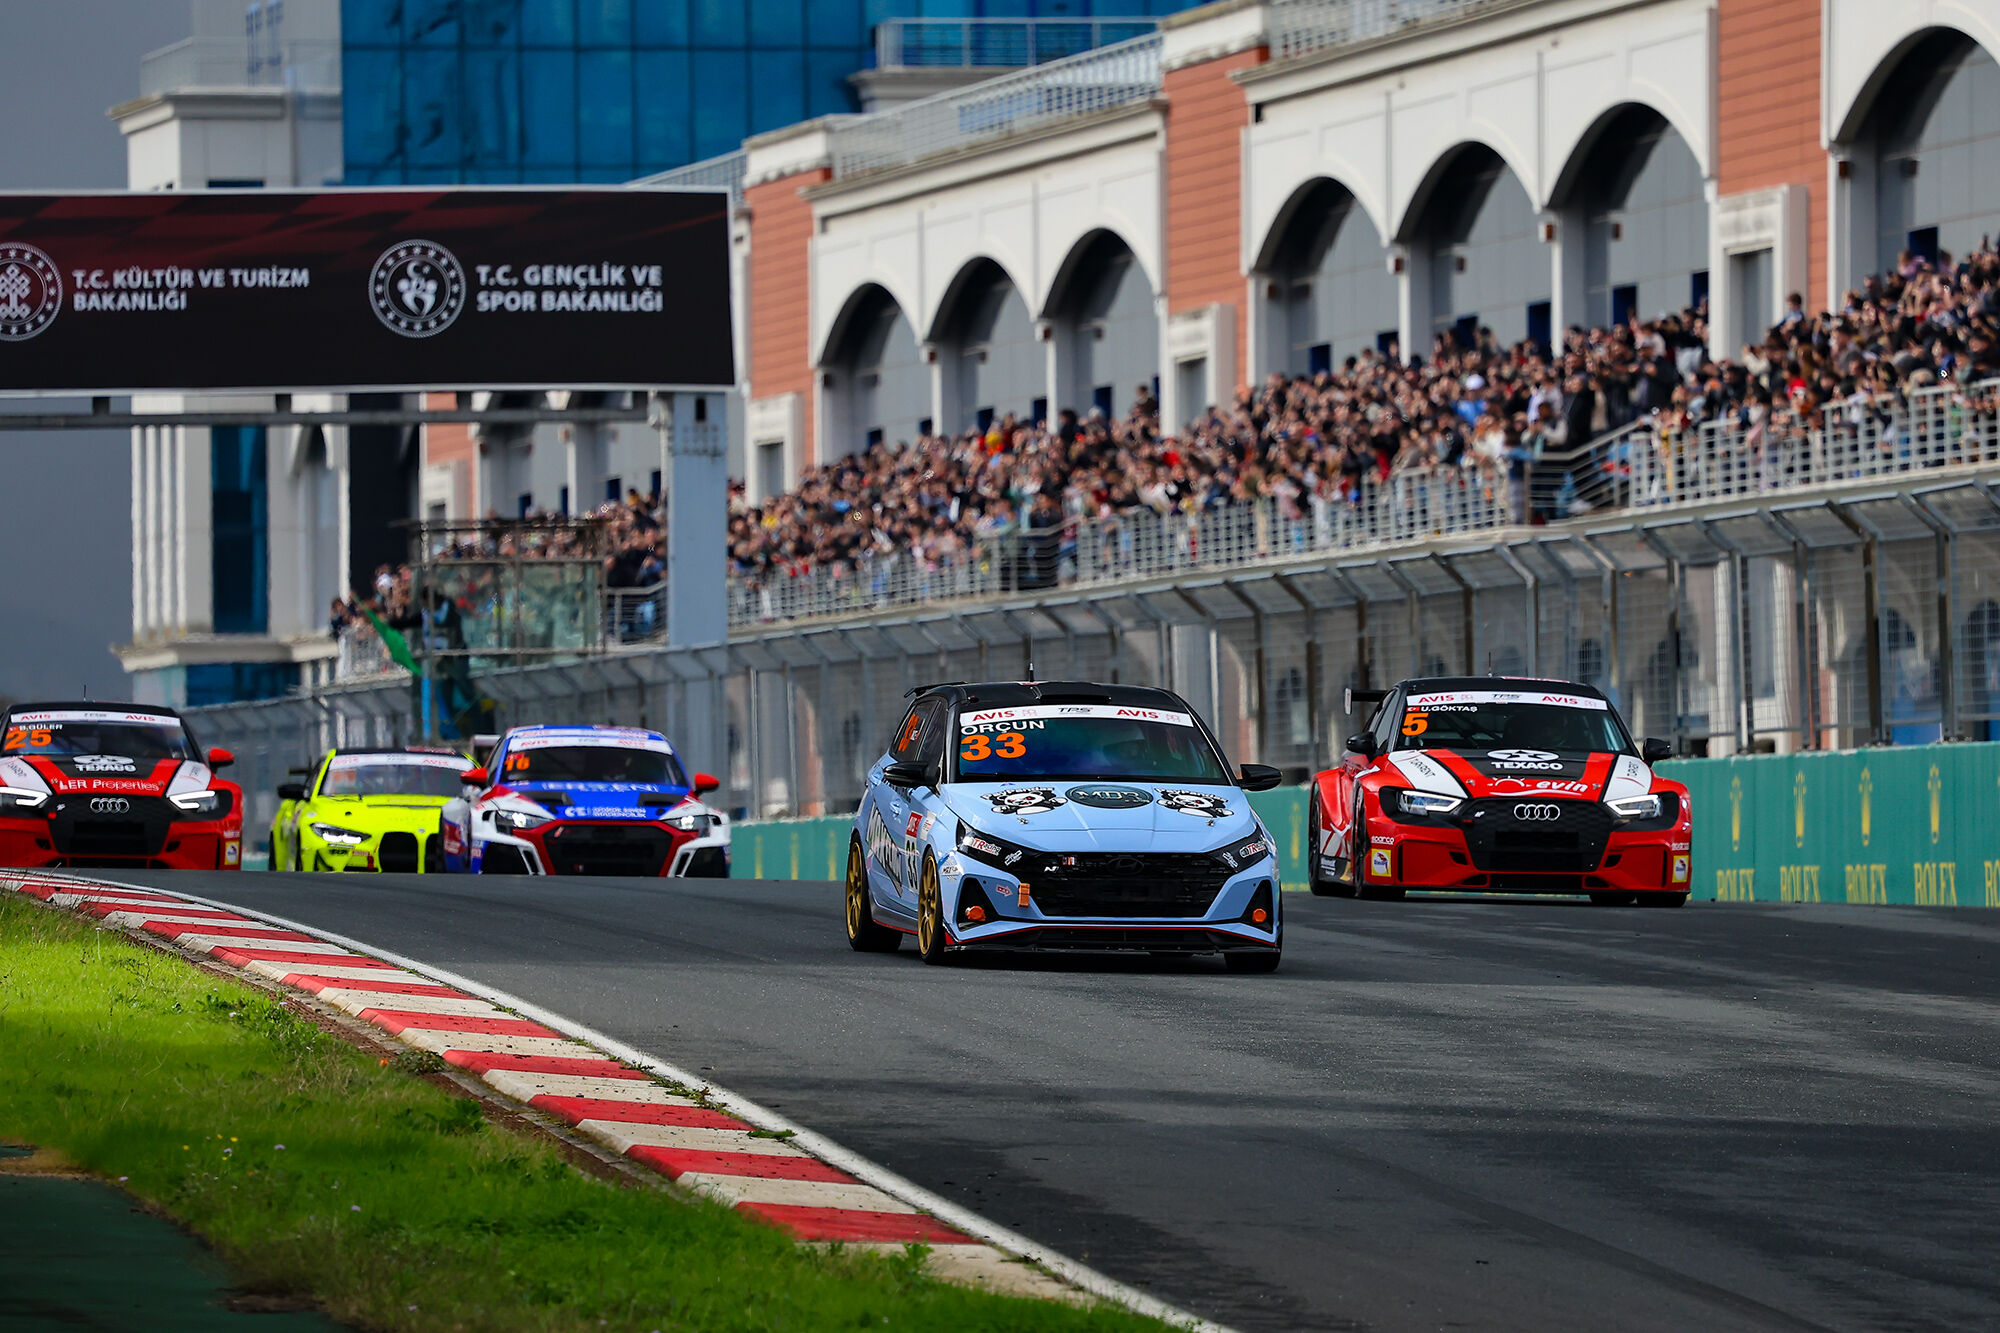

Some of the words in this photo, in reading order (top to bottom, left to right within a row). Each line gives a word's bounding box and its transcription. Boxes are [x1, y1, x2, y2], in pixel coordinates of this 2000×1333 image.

[72, 268, 109, 289] T.C.
[112, 264, 194, 289] KÜLTÜR
[198, 268, 225, 288] VE
[229, 264, 310, 288] TURİZM
[475, 264, 519, 287] T.C.
[523, 261, 626, 291] GENÇLİK
[631, 265, 662, 287] VE
[73, 290, 187, 311] BAKANLIĞI
[476, 290, 537, 312] SPOR
[541, 287, 663, 312] BAKANLIĞI
[1418, 695, 1455, 703] AVIS
[1542, 695, 1578, 705] AVIS
[972, 710, 1015, 722] AVIS
[1117, 709, 1159, 719] AVIS
[1421, 705, 1478, 713] U.GÖKTAŞ
[125, 714, 156, 722] AVIS
[1401, 713, 1429, 736] 5
[960, 720, 1045, 735] ORÇUN
[4, 729, 52, 751] 25
[960, 732, 1027, 762] 33
[75, 764, 137, 773] TEXACO
[1491, 762, 1564, 771] TEXACO
[92, 779, 160, 792] Properties
[1536, 779, 1588, 792] evin
[1371, 836, 1395, 845] sparco
[1716, 868, 1755, 902] ROLEX
[1780, 864, 1820, 903] ROLEX
[1845, 863, 1887, 905] ROLEX
[1914, 862, 1958, 907] ROLEX
